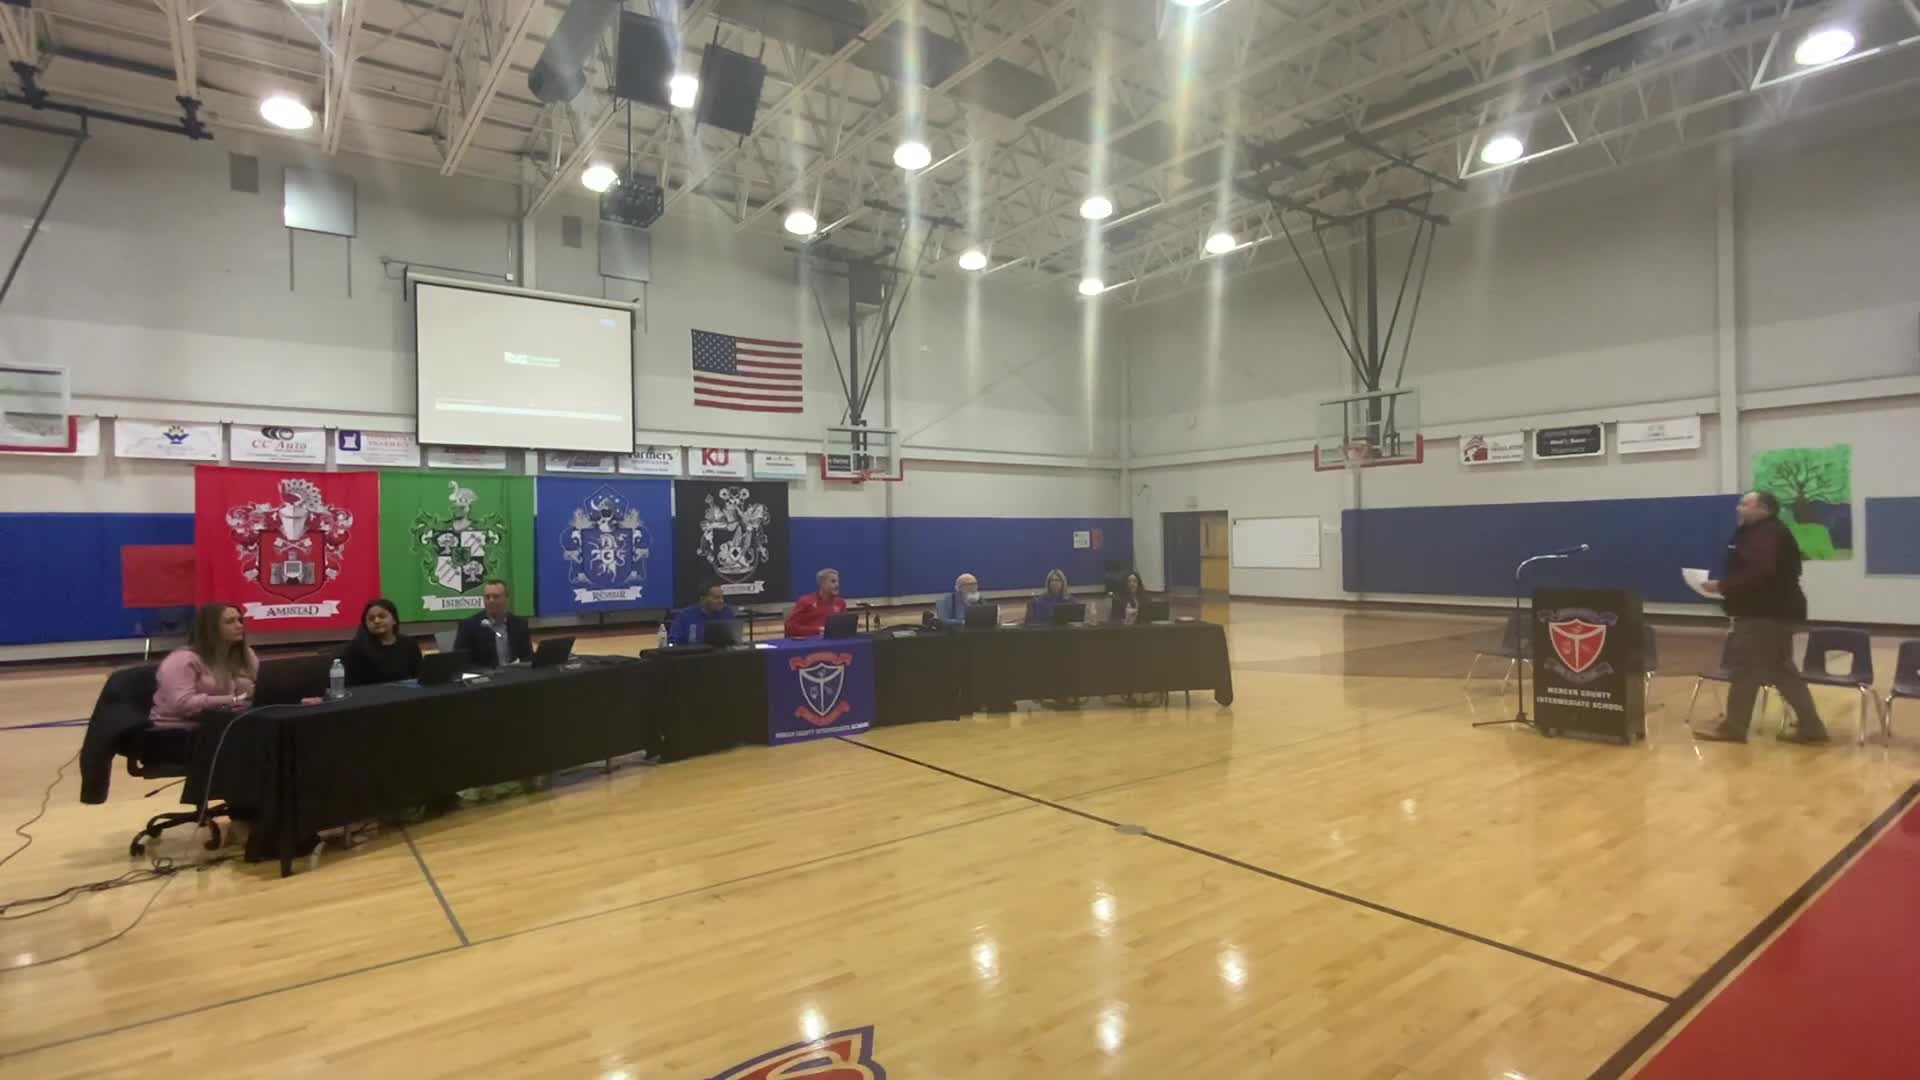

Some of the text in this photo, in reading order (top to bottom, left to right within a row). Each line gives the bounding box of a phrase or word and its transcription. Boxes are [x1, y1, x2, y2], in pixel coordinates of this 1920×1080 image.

[277, 440, 307, 450] Auto
[702, 447, 729, 465] KU
[266, 605, 320, 617] AMISTAD
[1547, 687, 1611, 699] MERCER COUNTY
[1536, 695, 1624, 711] INTERMEDIATE SCHOOL
